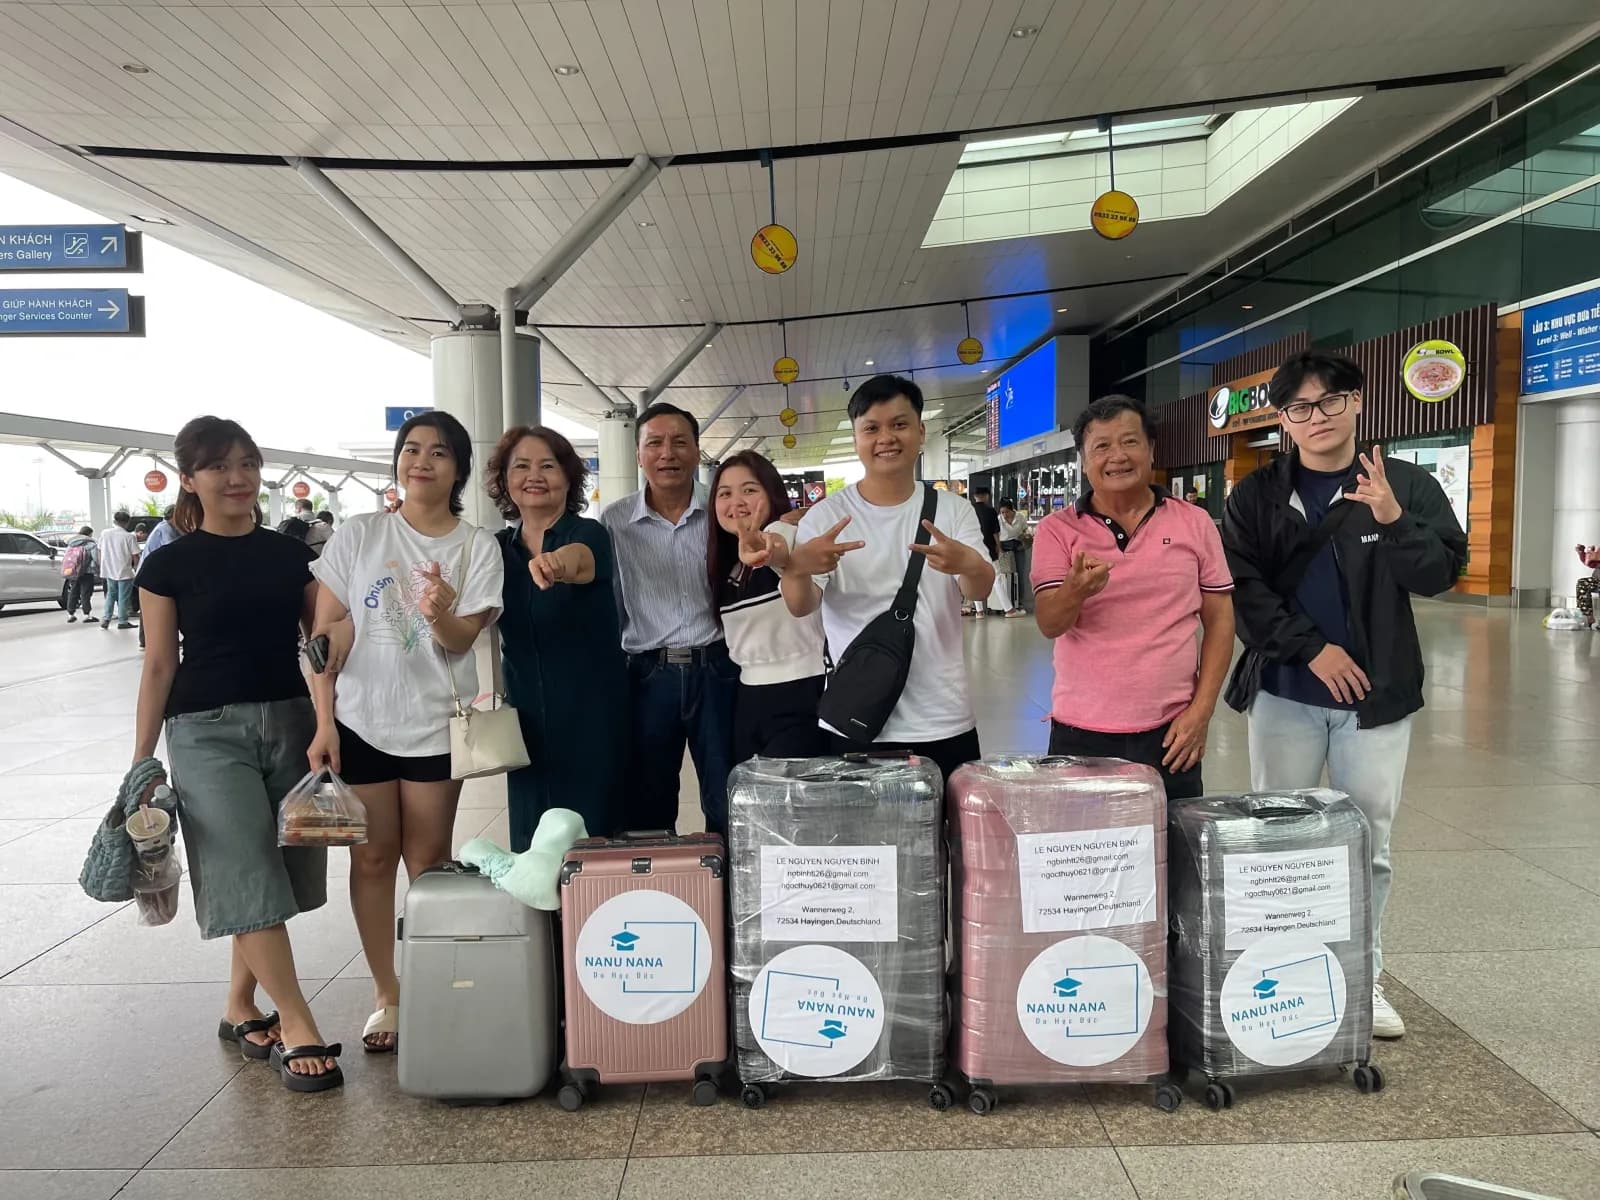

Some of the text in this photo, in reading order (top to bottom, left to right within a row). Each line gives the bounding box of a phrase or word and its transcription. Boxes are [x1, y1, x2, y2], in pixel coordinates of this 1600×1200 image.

[9, 232, 53, 245] KHÁCH
[16, 250, 52, 261] Gallery
[19, 312, 56, 321] Services
[58, 311, 93, 321] Counter
[1537, 335, 1553, 346] Level
[1228, 382, 1271, 416] BIGBO
[364, 576, 395, 609] Onism
[1034, 839, 1138, 855] LE NGUYEN NGUYEN BINH
[1239, 859, 1334, 874] LE NGUYEN NGUYEN BINH
[1038, 907, 1061, 916] 72534
[776, 917, 799, 925] 72534
[1241, 926, 1262, 934] 72534
[585, 956, 663, 967] NANU NANA
[798, 1000, 875, 1018] NANU NANA
[1027, 1001, 1106, 1013] NANU NANA
[1232, 996, 1305, 1022] NANU NANA
